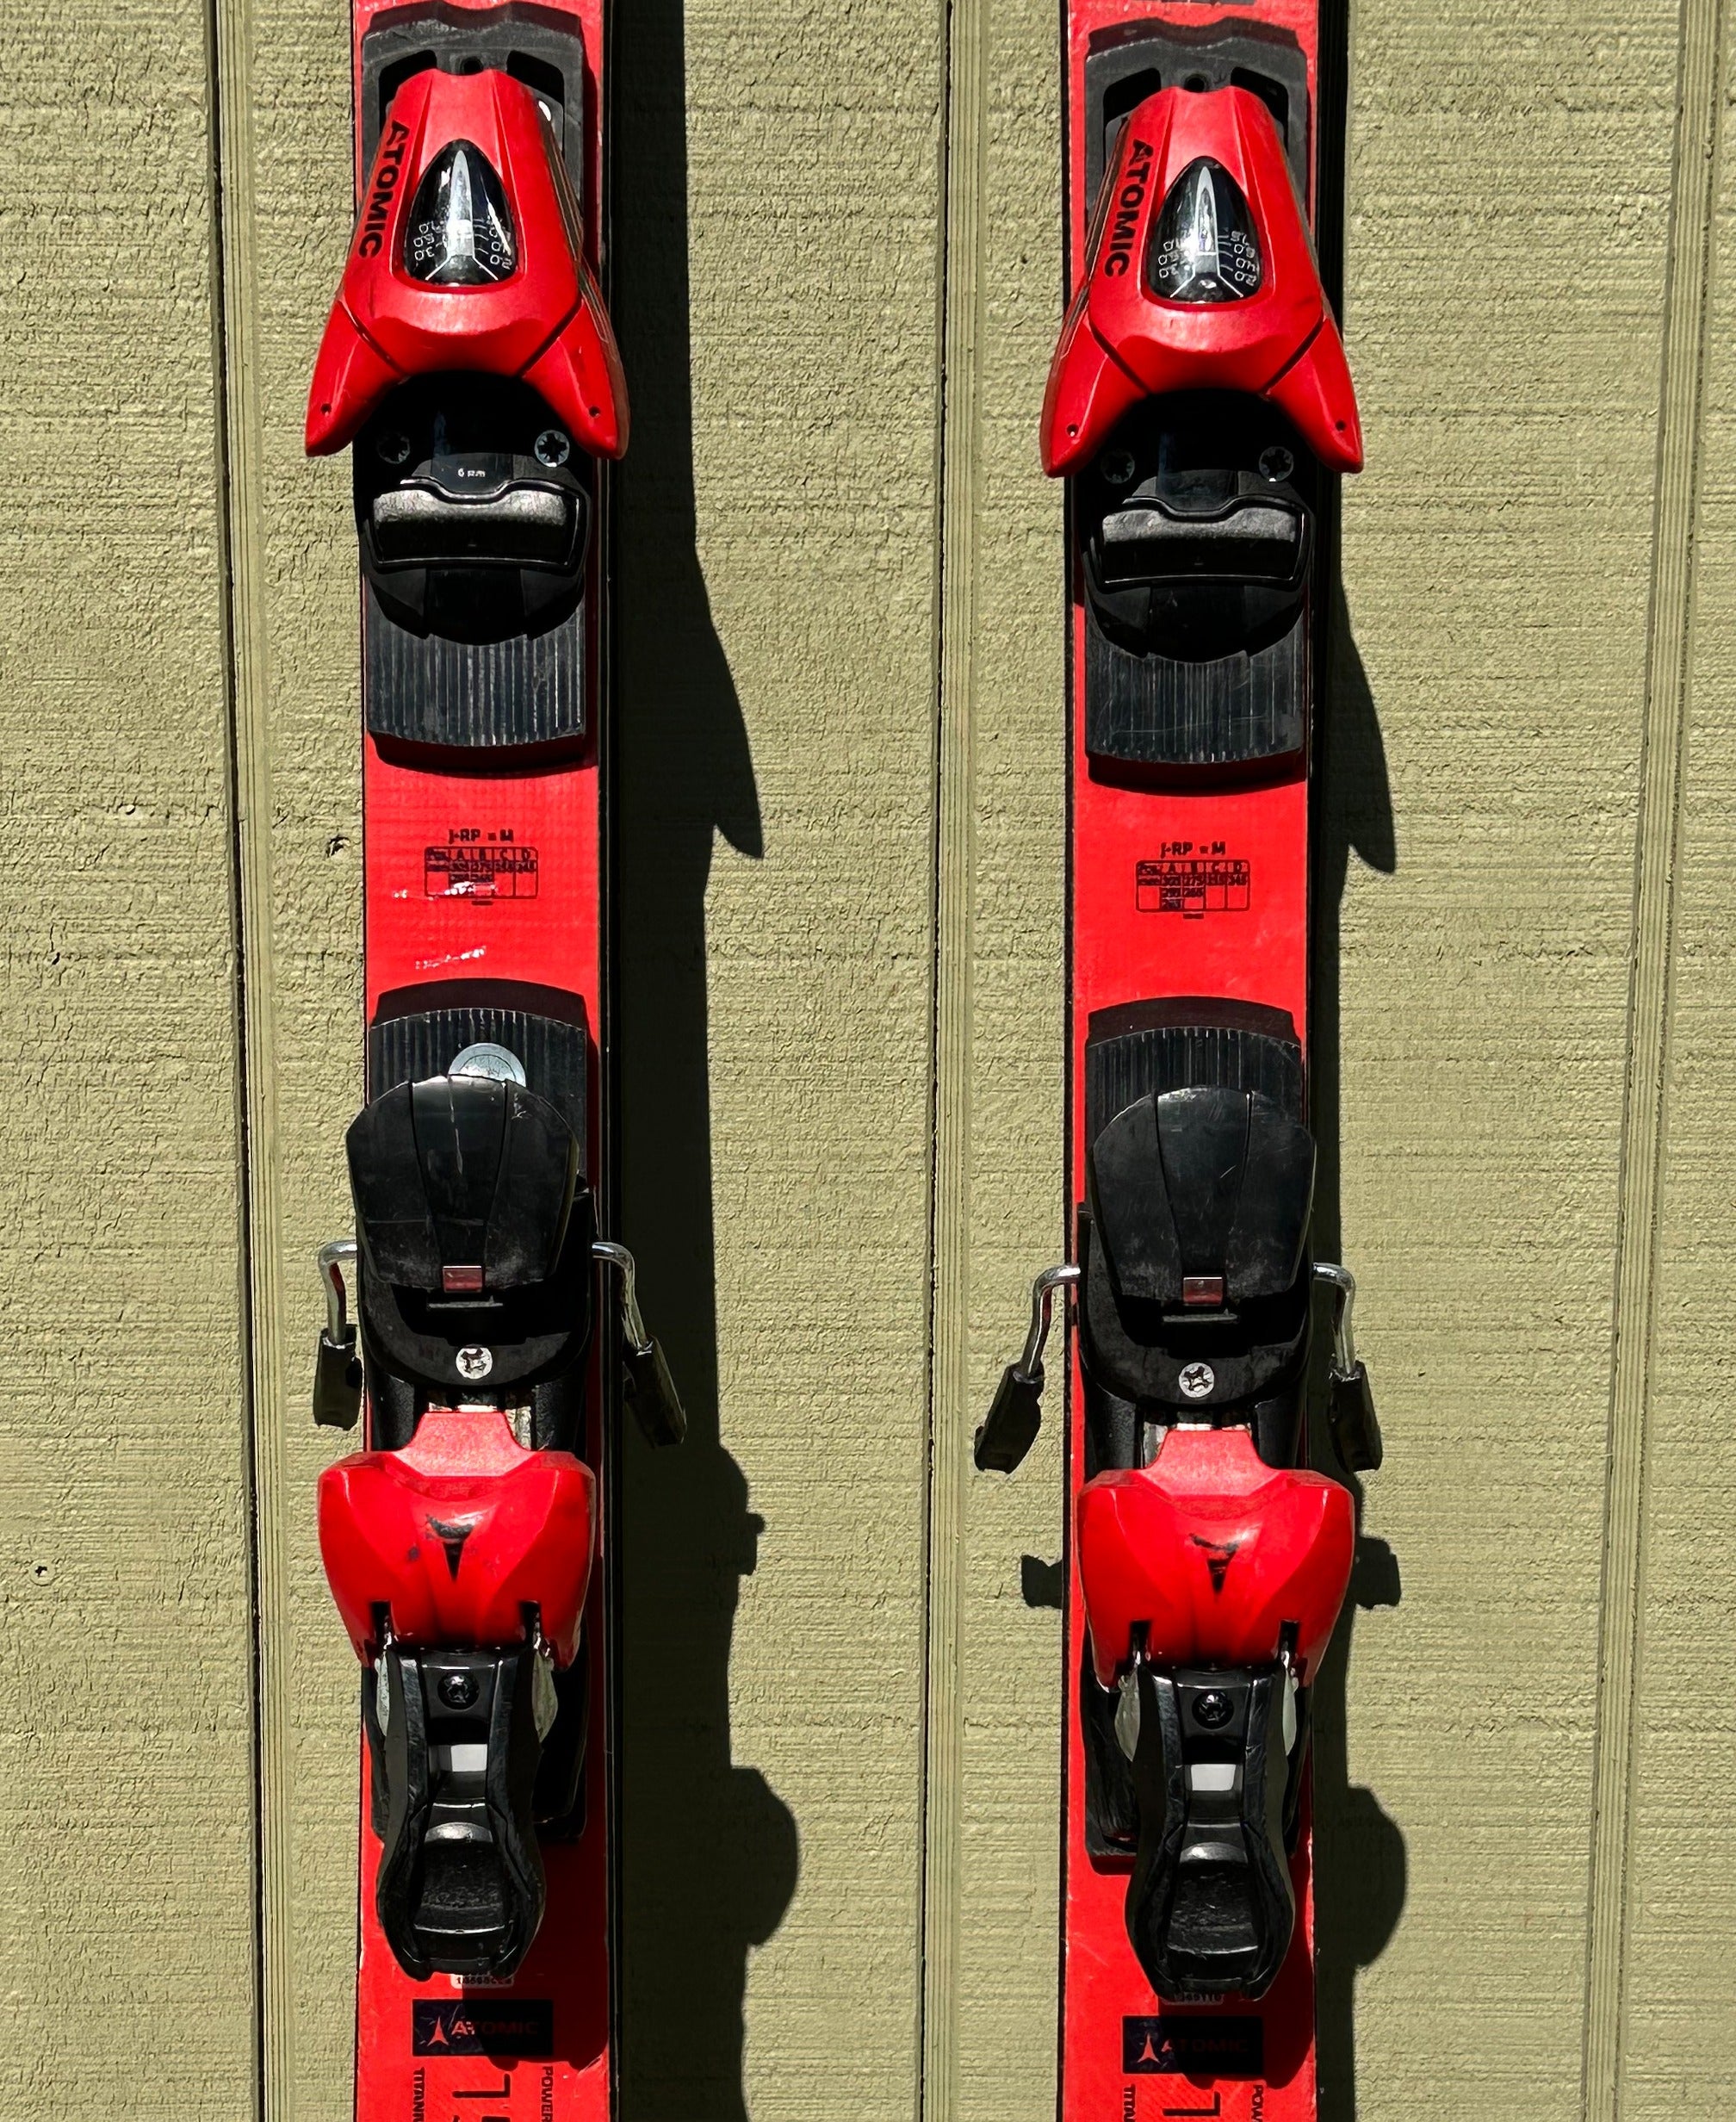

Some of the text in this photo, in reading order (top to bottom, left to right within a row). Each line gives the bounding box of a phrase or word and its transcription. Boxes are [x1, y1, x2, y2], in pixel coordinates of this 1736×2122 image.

[357, 121, 410, 258] ATOMIC
[1105, 139, 1154, 277] ATOMIC
[457, 468, 464, 478] 6
